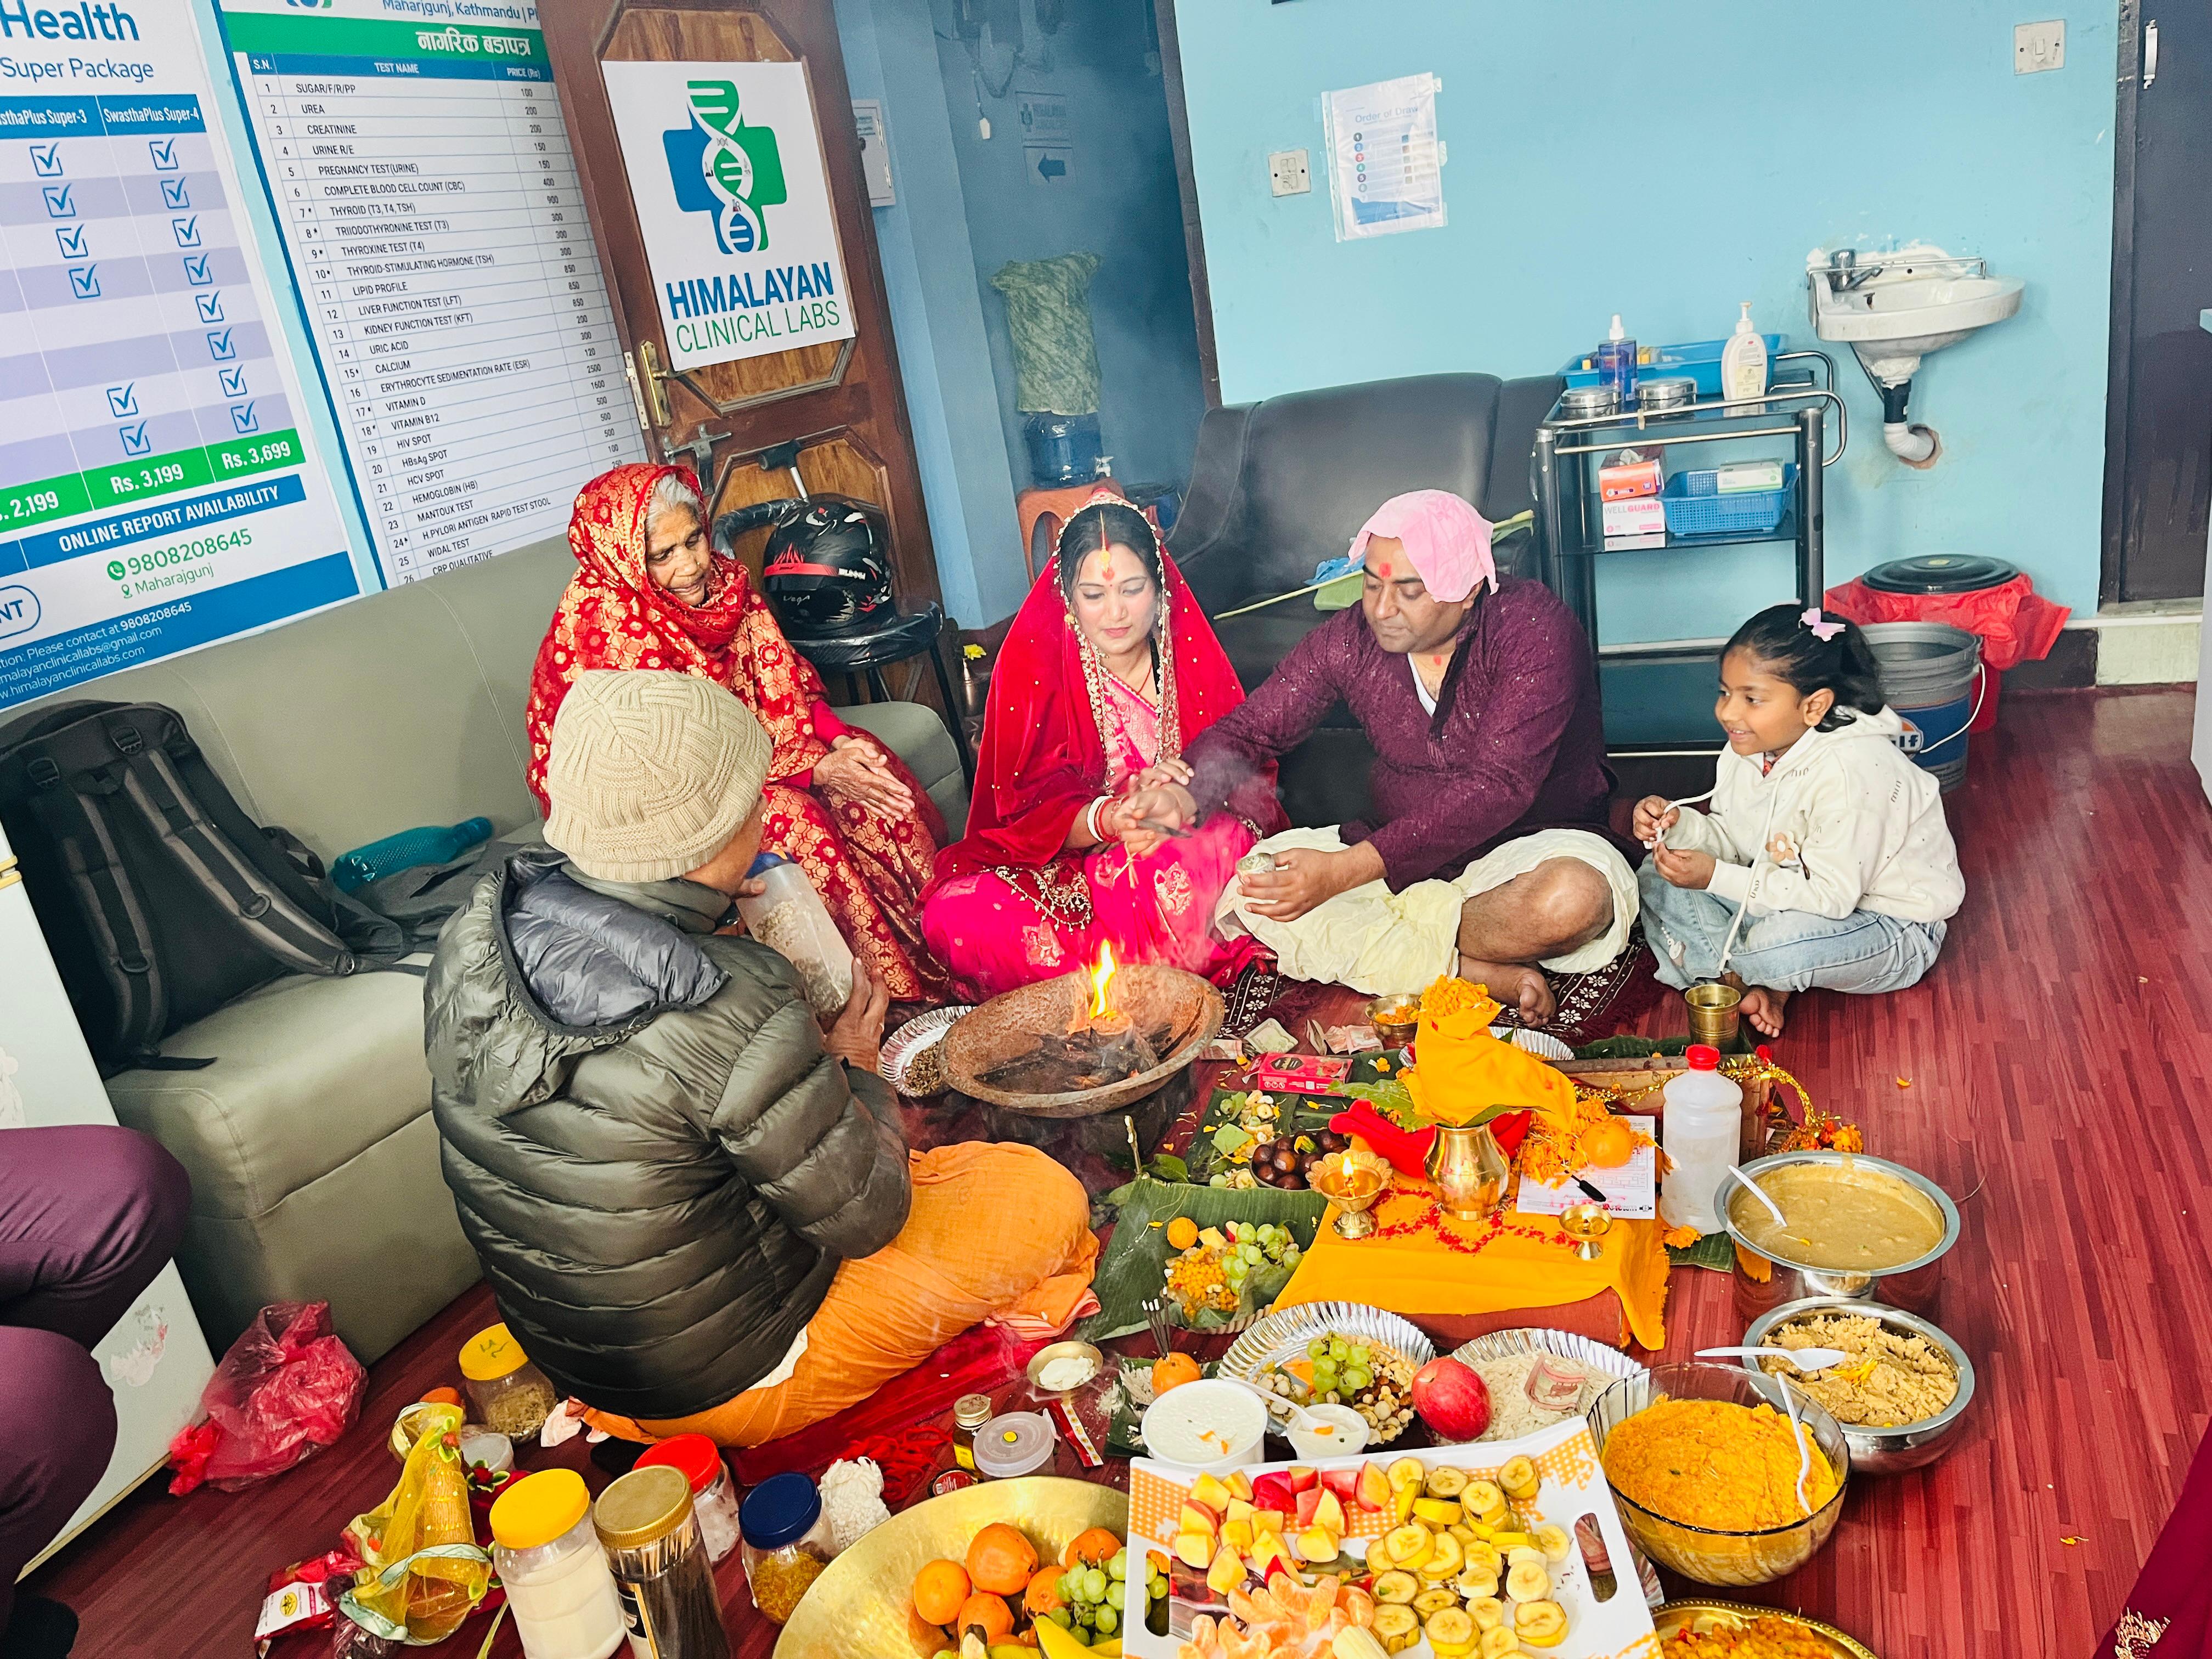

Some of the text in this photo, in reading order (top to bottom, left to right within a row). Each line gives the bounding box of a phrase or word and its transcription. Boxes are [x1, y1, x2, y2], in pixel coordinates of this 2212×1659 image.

[0, 0, 139, 41] Health
[455, 1, 520, 19] Kathmandu
[415, 26, 479, 53] नागरिक
[0, 57, 154, 83] Super Package
[253, 59, 527, 77] S.N. TEST NAME PRICE
[265, 83, 533, 97] 1 SUGAR/F/R/PP 100
[48, 109, 87, 127] Super-3
[104, 106, 200, 124] SwasthaPlus Super-4
[270, 104, 537, 115] 2 UREA 200
[1355, 112, 1381, 123] Order
[1383, 109, 1392, 118] of
[1395, 106, 1419, 116] Draw
[276, 125, 541, 135] 3 CREATININE 200
[283, 142, 546, 155] 4 URINE R/E 150
[288, 167, 294, 177] 5
[318, 165, 369, 176] PREGNANCY
[538, 160, 550, 169] 150
[294, 178, 555, 198] 6 COMPLETE BLOOD CELL COUNT (CBC) 400
[329, 205, 366, 217] THYROID
[368, 205, 383, 216] (T3,
[383, 204, 397, 215] T4,
[396, 202, 416, 214] TSH)
[547, 195, 558, 204] 900
[335, 223, 413, 236] TRIIODOTHYRONINE
[414, 222, 433, 232] TEST
[434, 220, 449, 232] (T3)
[551, 213, 563, 222] 300
[341, 244, 387, 257] THYROXINE
[388, 242, 408, 252] TEST
[409, 241, 425, 252] (T4)
[556, 230, 567, 239] 300
[347, 259, 437, 276] THYROID-STIMULATING
[437, 256, 475, 268] HORMONE
[475, 254, 494, 266] (TSH)
[560, 247, 572, 256] 300
[321, 264, 575, 300] 11 LIPID PROFILE 850
[665, 262, 834, 320] HIMALAYAN
[327, 281, 580, 320] 12 LIVER FUNCTION TEST (LFT) 850
[332, 298, 584, 339] 13 KIDNEY FUNCTION TEST (KFT) 850
[675, 300, 841, 353] CLINICAL LABS
[338, 315, 588, 359] 14 URIC ACID 200
[375, 360, 411, 374] CALCIUM
[580, 331, 592, 340] 300
[350, 347, 596, 398] 16 ERYTHROCYTE SEDIMENTATION RATE (ESR) 120
[385, 398, 419, 412] VITAMIN
[419, 396, 426, 405] D
[586, 364, 601, 374] 2500
[391, 417, 424, 431] VITAMIN
[425, 413, 440, 425] B12
[591, 380, 605, 390] 1600
[367, 396, 607, 455] 19 HIV SPOT 500
[221, 440, 291, 470] Rs. 3,699
[372, 413, 611, 475] 20 HBsAg SPOT 500
[377, 428, 615, 493] 21 HCV SPOT 500
[110, 463, 184, 495] Rs. 3,199
[383, 444, 619, 512] 22 HEMOGLOBIN (HB) 100
[9, 490, 59, 518] 2,199
[58, 485, 279, 552] ONLINE REPORT AVAILABILITY
[388, 499, 474, 531] 23 MANTOUX TEST
[422, 522, 456, 540] H.PYLORI
[458, 514, 488, 529] ANTIGEN
[490, 507, 512, 521] RAPID
[512, 502, 529, 514] TEST
[529, 496, 551, 510] STOOL
[127, 528, 252, 575] 9808208645
[398, 538, 471, 567] 25 WIDAL TEST
[134, 562, 215, 595] Maharajgunj
[432, 562, 448, 575] CRP
[26, 601, 193, 660] Please contact at 9808208645
